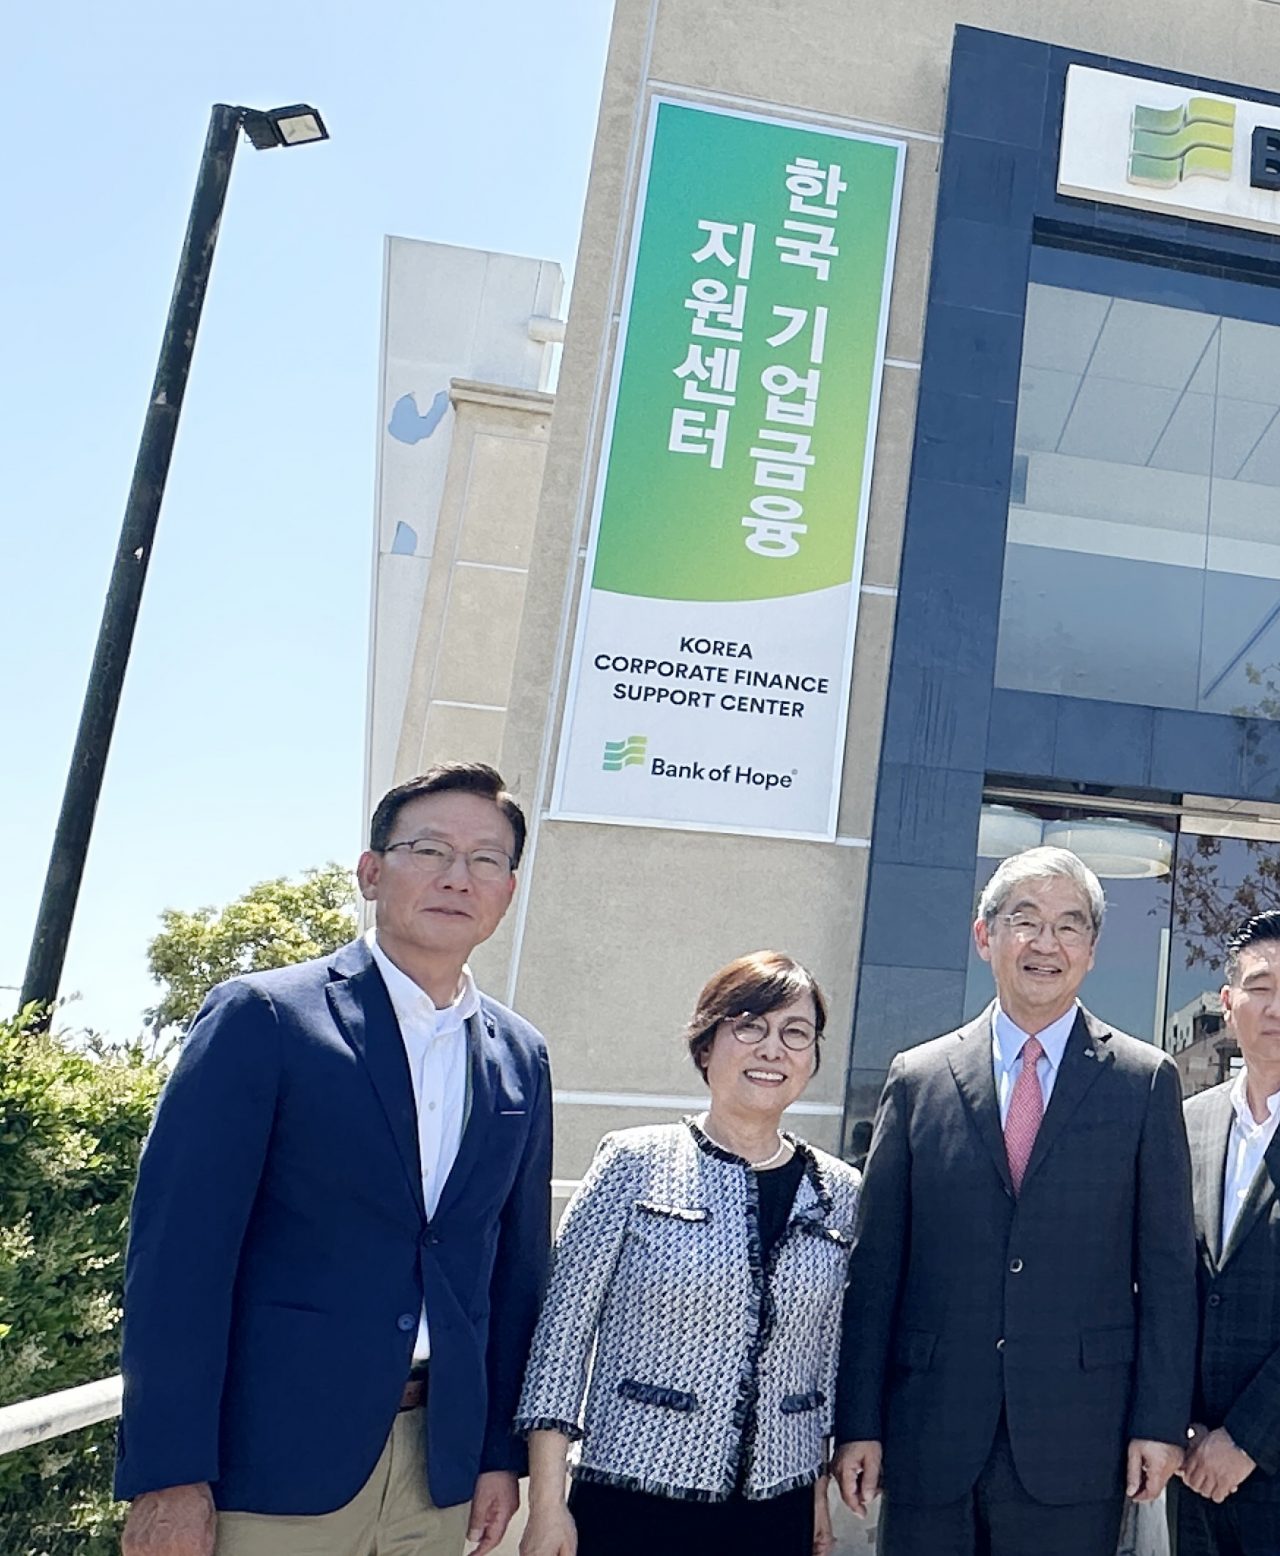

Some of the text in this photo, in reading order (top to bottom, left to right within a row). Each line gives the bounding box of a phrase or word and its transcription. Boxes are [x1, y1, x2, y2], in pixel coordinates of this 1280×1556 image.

[668, 219, 757, 469] 지원센터
[741, 156, 848, 558] 한국 기업금융
[679, 637, 753, 660] KOREA
[594, 654, 830, 694] CORPORATE FINANCE
[613, 683, 805, 718] SUPPORT CENTER
[651, 757, 705, 780] Bank
[708, 764, 732, 782] of
